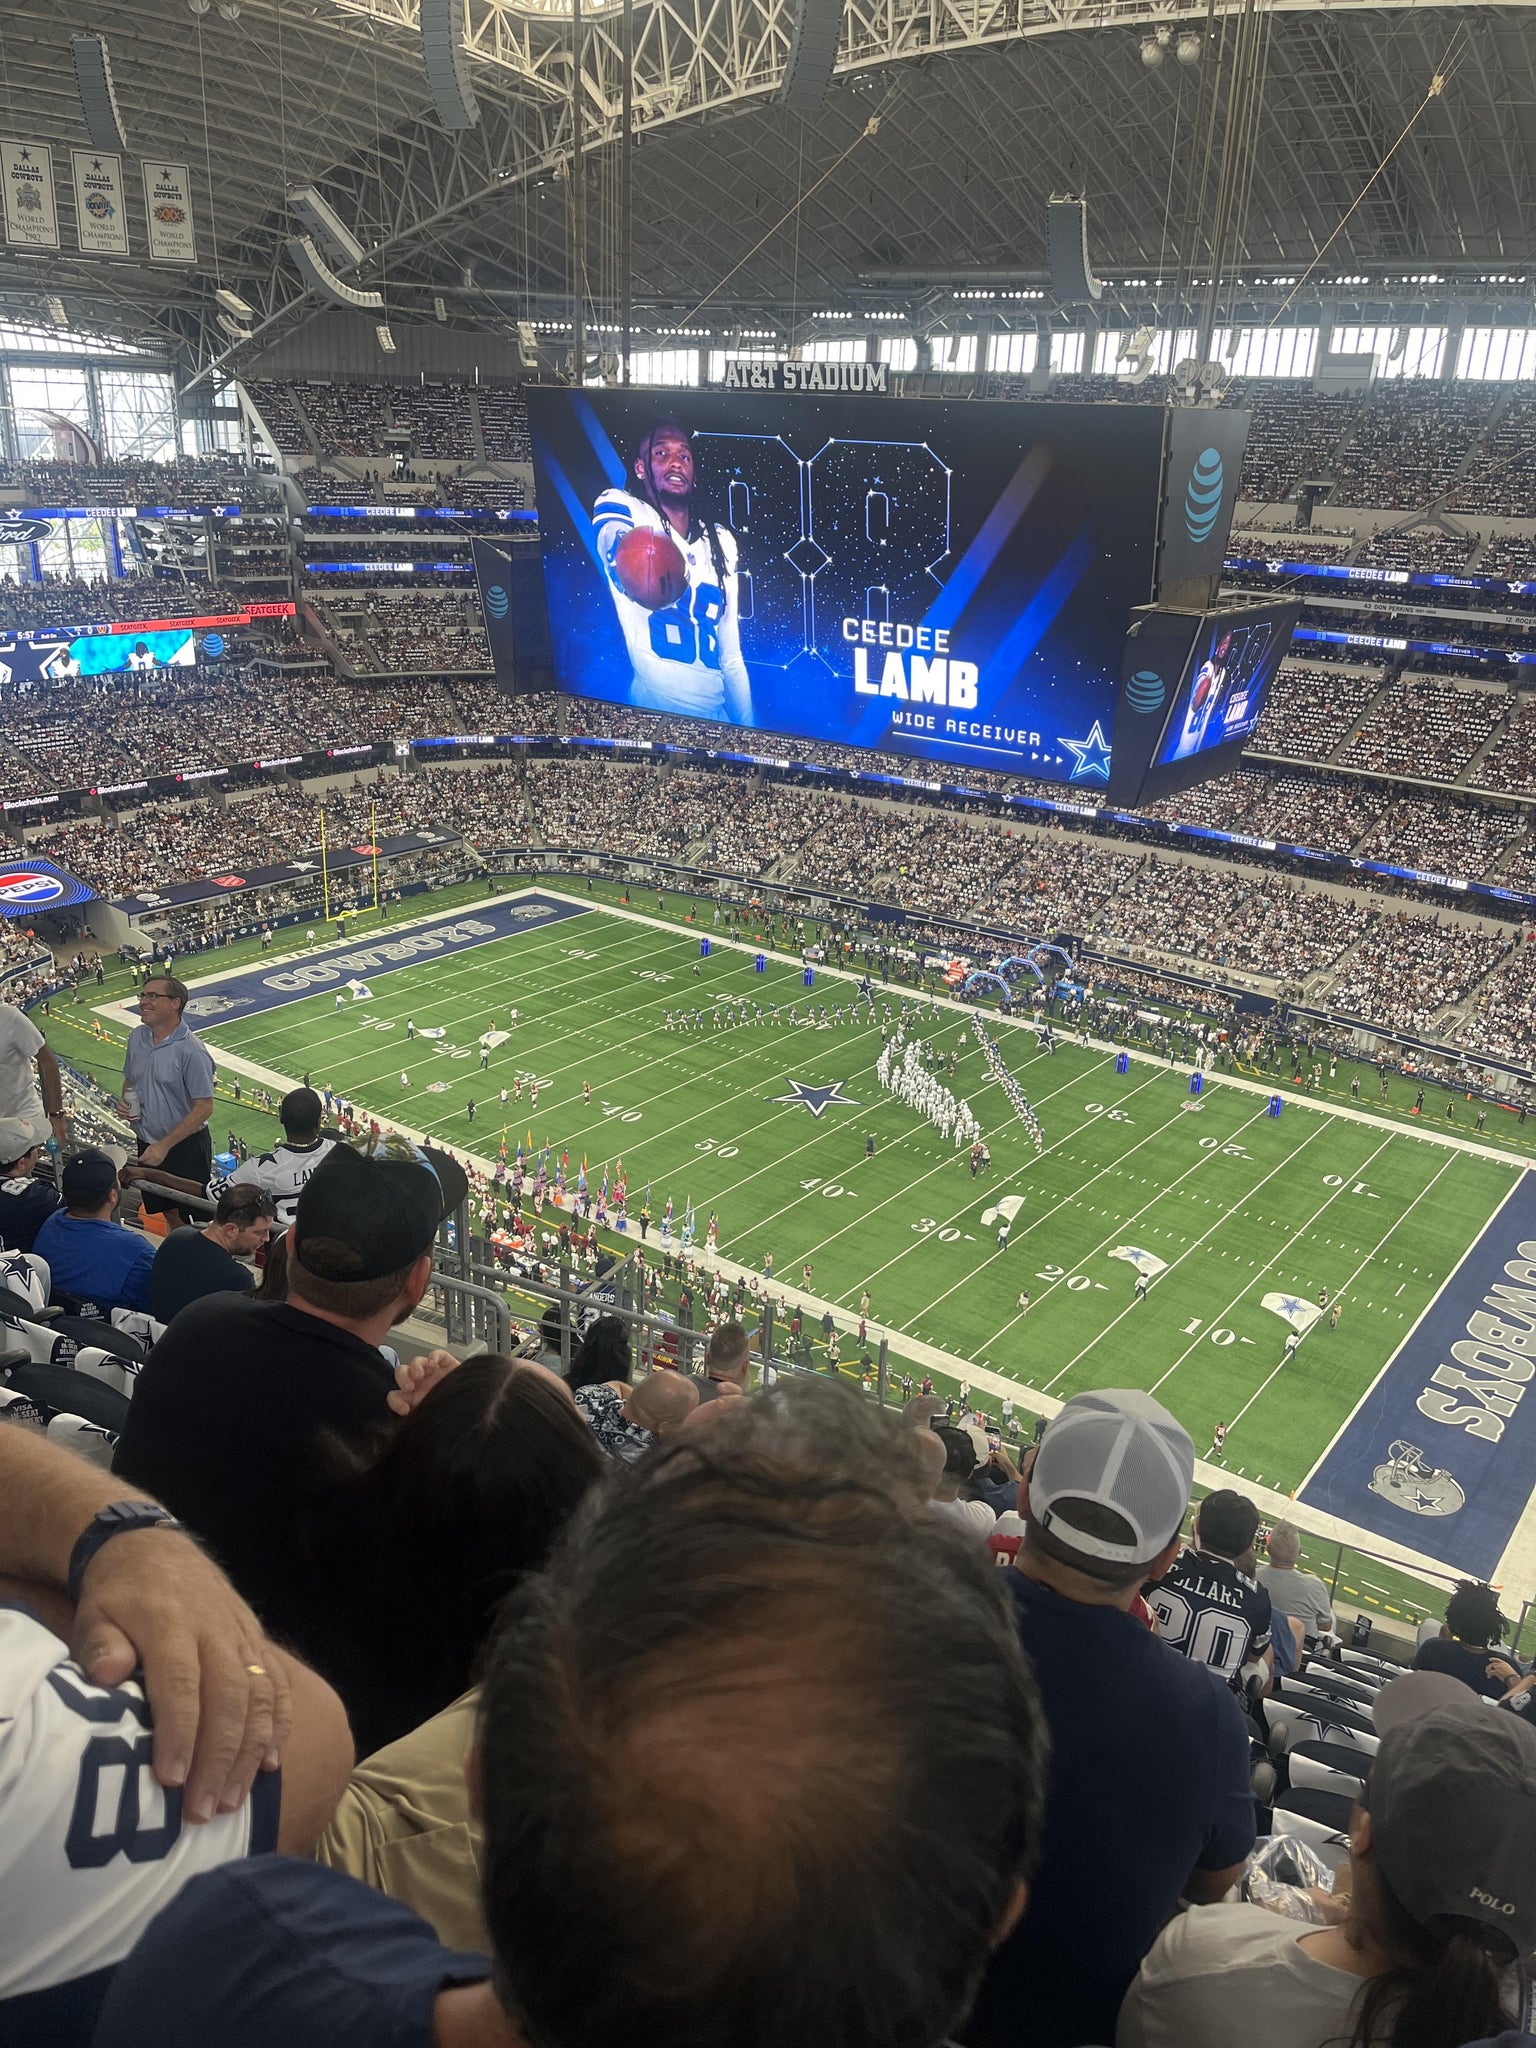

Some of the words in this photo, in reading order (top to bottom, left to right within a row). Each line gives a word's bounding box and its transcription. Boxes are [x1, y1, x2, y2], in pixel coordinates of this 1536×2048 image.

[13, 164, 40, 174] DALLAS
[11, 172, 43, 182] COWBOYS
[85, 173, 110, 182] DALLAS
[83, 181, 114, 191] COWBOYS
[155, 183, 179, 192] DALLAS
[153, 191, 182, 200] COWBOYS
[17, 213, 45, 223] WORLD
[10, 222, 55, 233] CHAMPIONS
[90, 222, 115, 231] WORLD
[82, 231, 124, 241] CHAMPIONS
[159, 230, 184, 240] WORLD
[153, 238, 192, 249] CHAMPIONS
[725, 361, 778, 389] AT&T
[783, 362, 887, 392] STADIUM
[86, 507, 117, 517] CEEDEE
[366, 507, 395, 516] CEEDEE
[364, 563, 393, 571] CEEDEE
[1349, 568, 1383, 580] CEEDEE
[1384, 571, 1409, 583] LAMB
[245, 603, 289, 616] SEATGEEK
[1388, 605, 1414, 613] PERKINS
[169, 619, 195, 628] SEATGEEK
[216, 616, 241, 624] SEATGEEK
[120, 623, 148, 632] SEATGEEK
[17, 630, 35, 641] 5:57
[842, 617, 952, 653] CEEDEE
[1347, 634, 1382, 647] CEEDEE
[1382, 638, 1407, 650] LAMB
[854, 647, 980, 710] LAMB
[892, 710, 936, 731] WIDE
[946, 719, 1042, 747] RECEIVER
[333, 745, 373, 757] Blockchain.com
[260, 755, 303, 768] Blockchain.com
[182, 767, 229, 781] Blockchain.com
[97, 780, 148, 795] Blockchain.com
[3, 794, 59, 810] Blockchain.com
[1055, 803, 1079, 814] CEEDEE
[1230, 834, 1258, 847] CEEDEE
[1257, 838, 1276, 850] LAMB
[0, 879, 57, 896] PEPSI
[1416, 872, 1446, 885] CEEDEE
[1446, 878, 1468, 890] LAMB
[147, 898, 173, 908] AT&T
[258, 958, 275, 967] IT
[284, 942, 342, 959] TAKES
[348, 932, 377, 943] ALL
[382, 924, 401, 933] OF
[405, 918, 430, 928] US
[262, 919, 496, 992] COWBOYS
[359, 1014, 396, 1033] 10
[432, 1040, 472, 1060] 20
[515, 1069, 555, 1090] 30
[601, 1100, 644, 1124] 40
[694, 1138, 740, 1159] 50
[799, 1177, 846, 1198] 40
[1322, 1173, 1374, 1197] 10
[910, 1216, 963, 1243] 30
[1034, 1263, 1091, 1292] 20
[1178, 1315, 1237, 1347] 10
[10, 1408, 39, 1420] IN-SEAT
[12, 1403, 33, 1412] VISA
[1469, 1886, 1516, 1915] POLO
